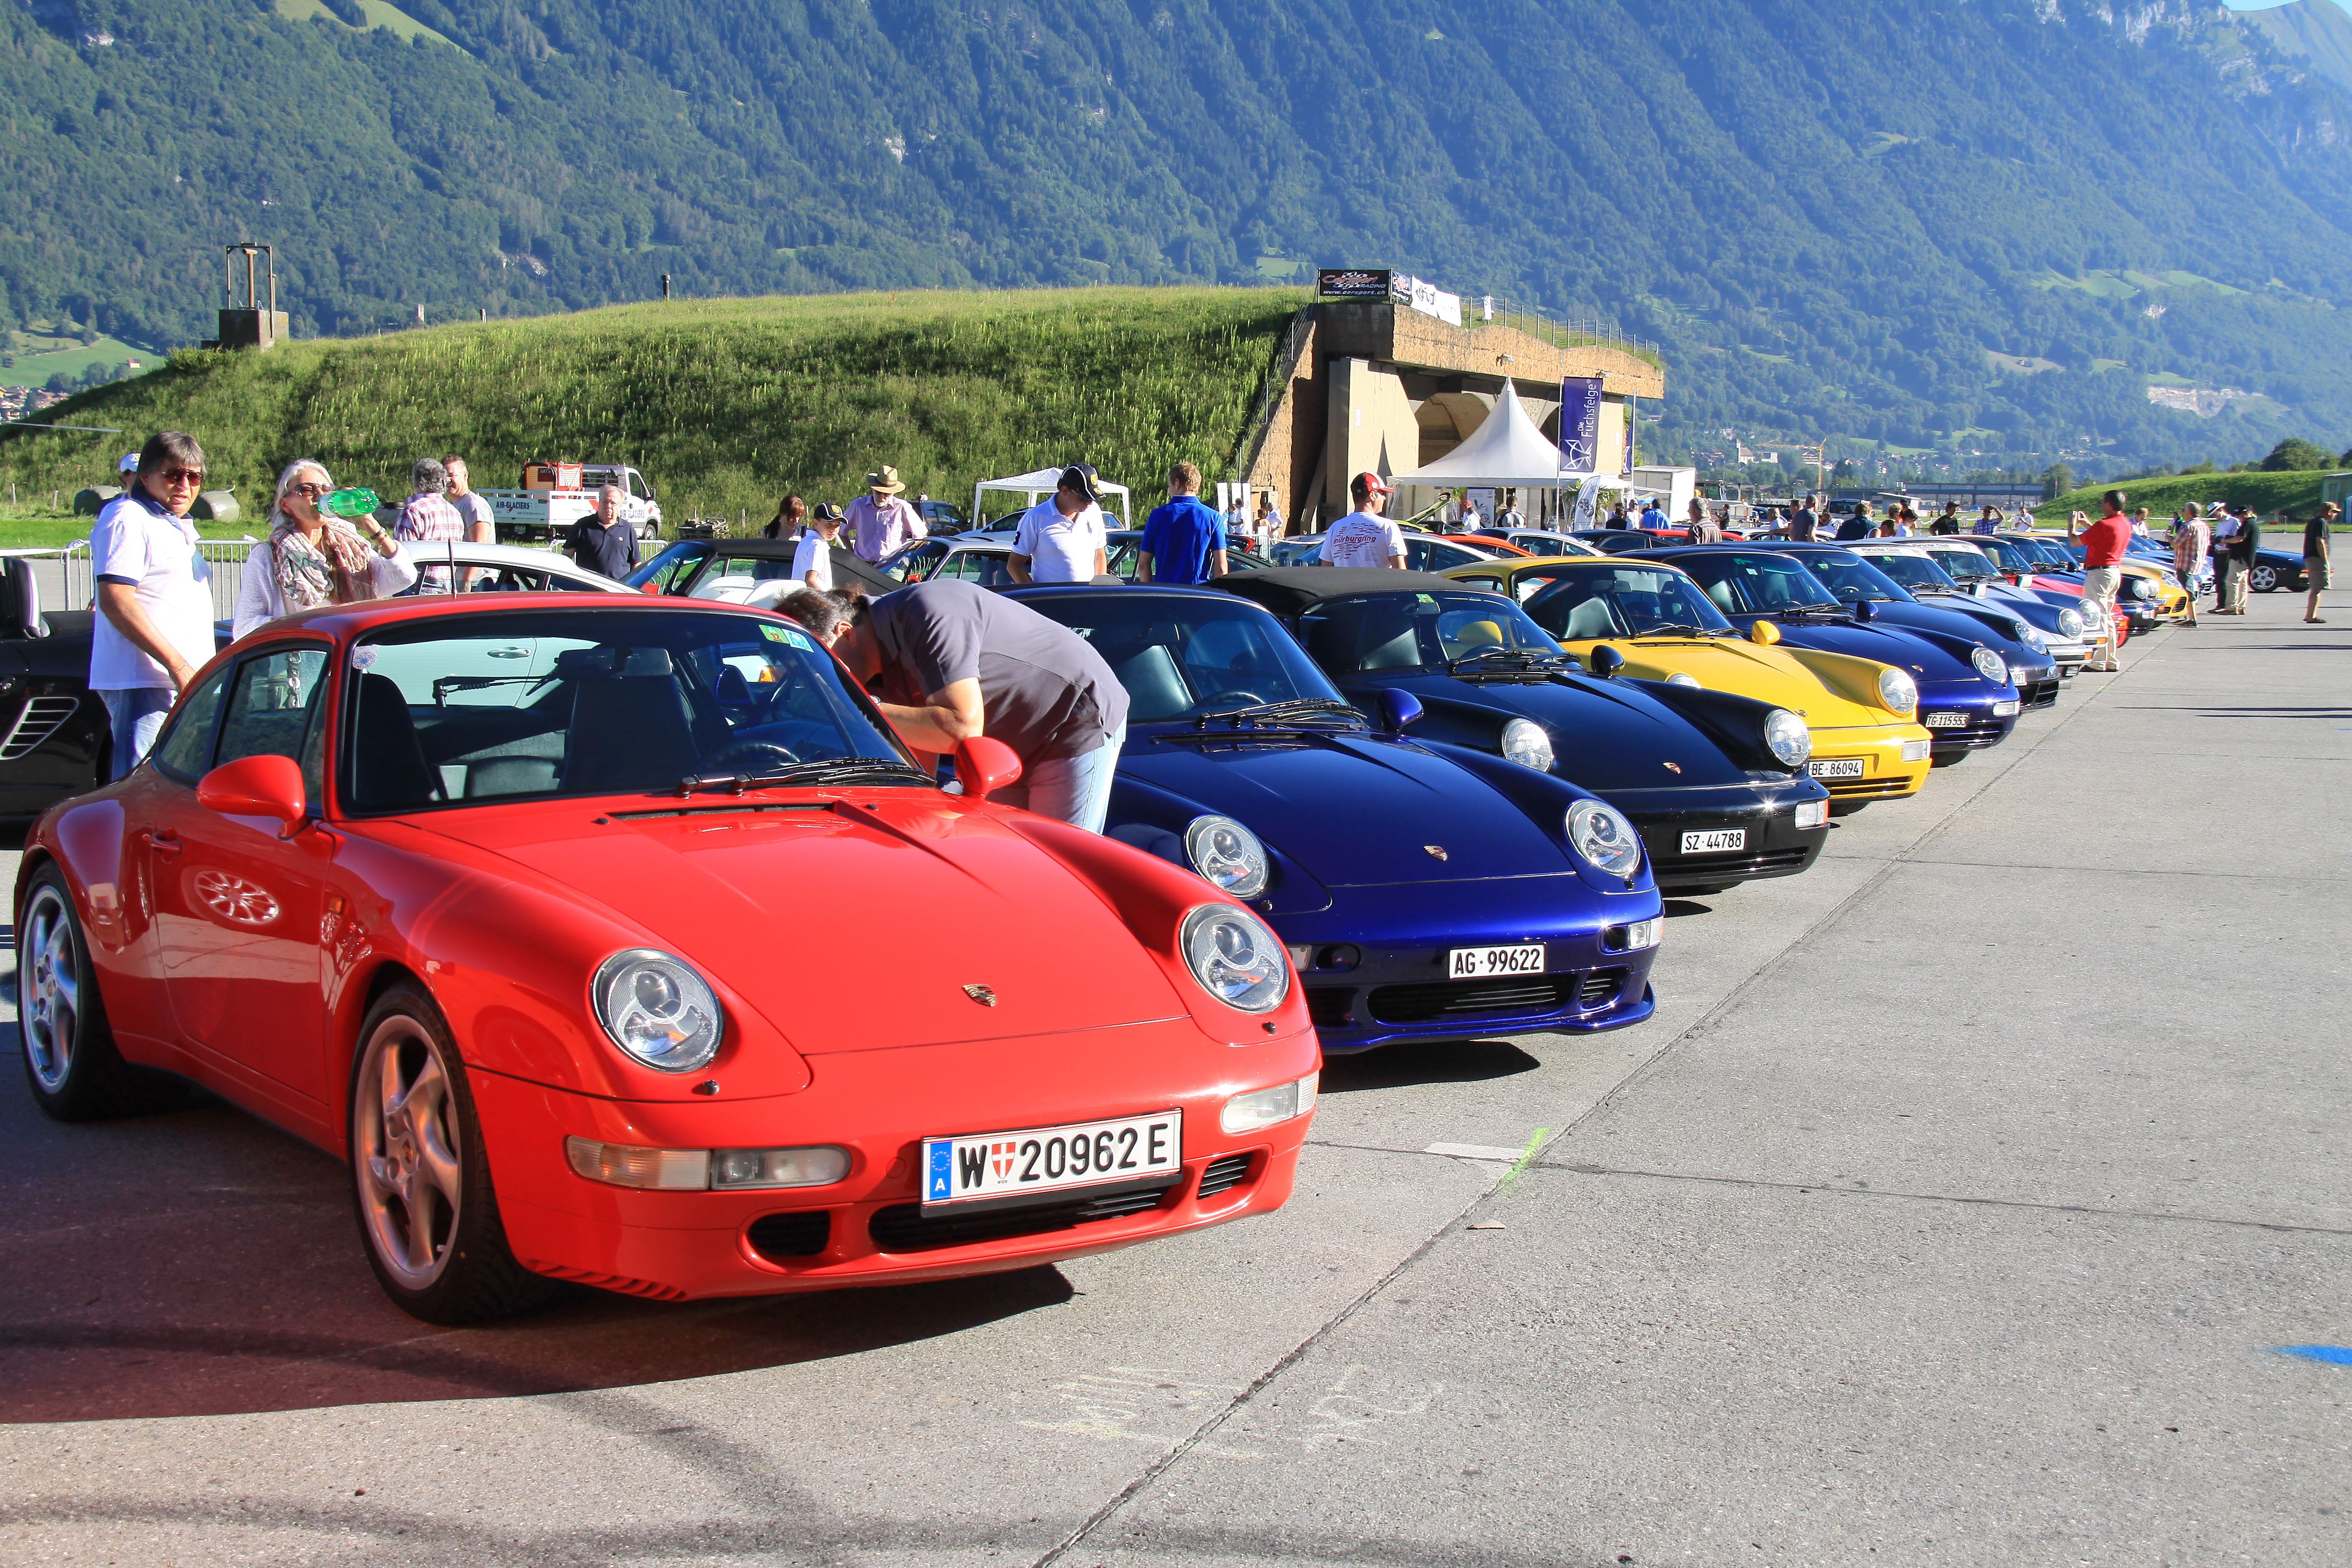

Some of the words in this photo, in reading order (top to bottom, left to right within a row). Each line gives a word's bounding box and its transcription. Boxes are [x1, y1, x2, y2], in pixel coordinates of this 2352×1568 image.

[1322, 275, 1378, 285] Carsport
[496, 501, 530, 509] AIR-GLACIERS
[1334, 535, 1376, 543] nürburgring
[1707, 833, 1742, 849] 44788
[1487, 948, 1540, 973] 99622
[958, 1144, 987, 1189] W
[1019, 1127, 1138, 1182] 20962
[1148, 1123, 1169, 1166] E
[934, 1178, 945, 1191] A
